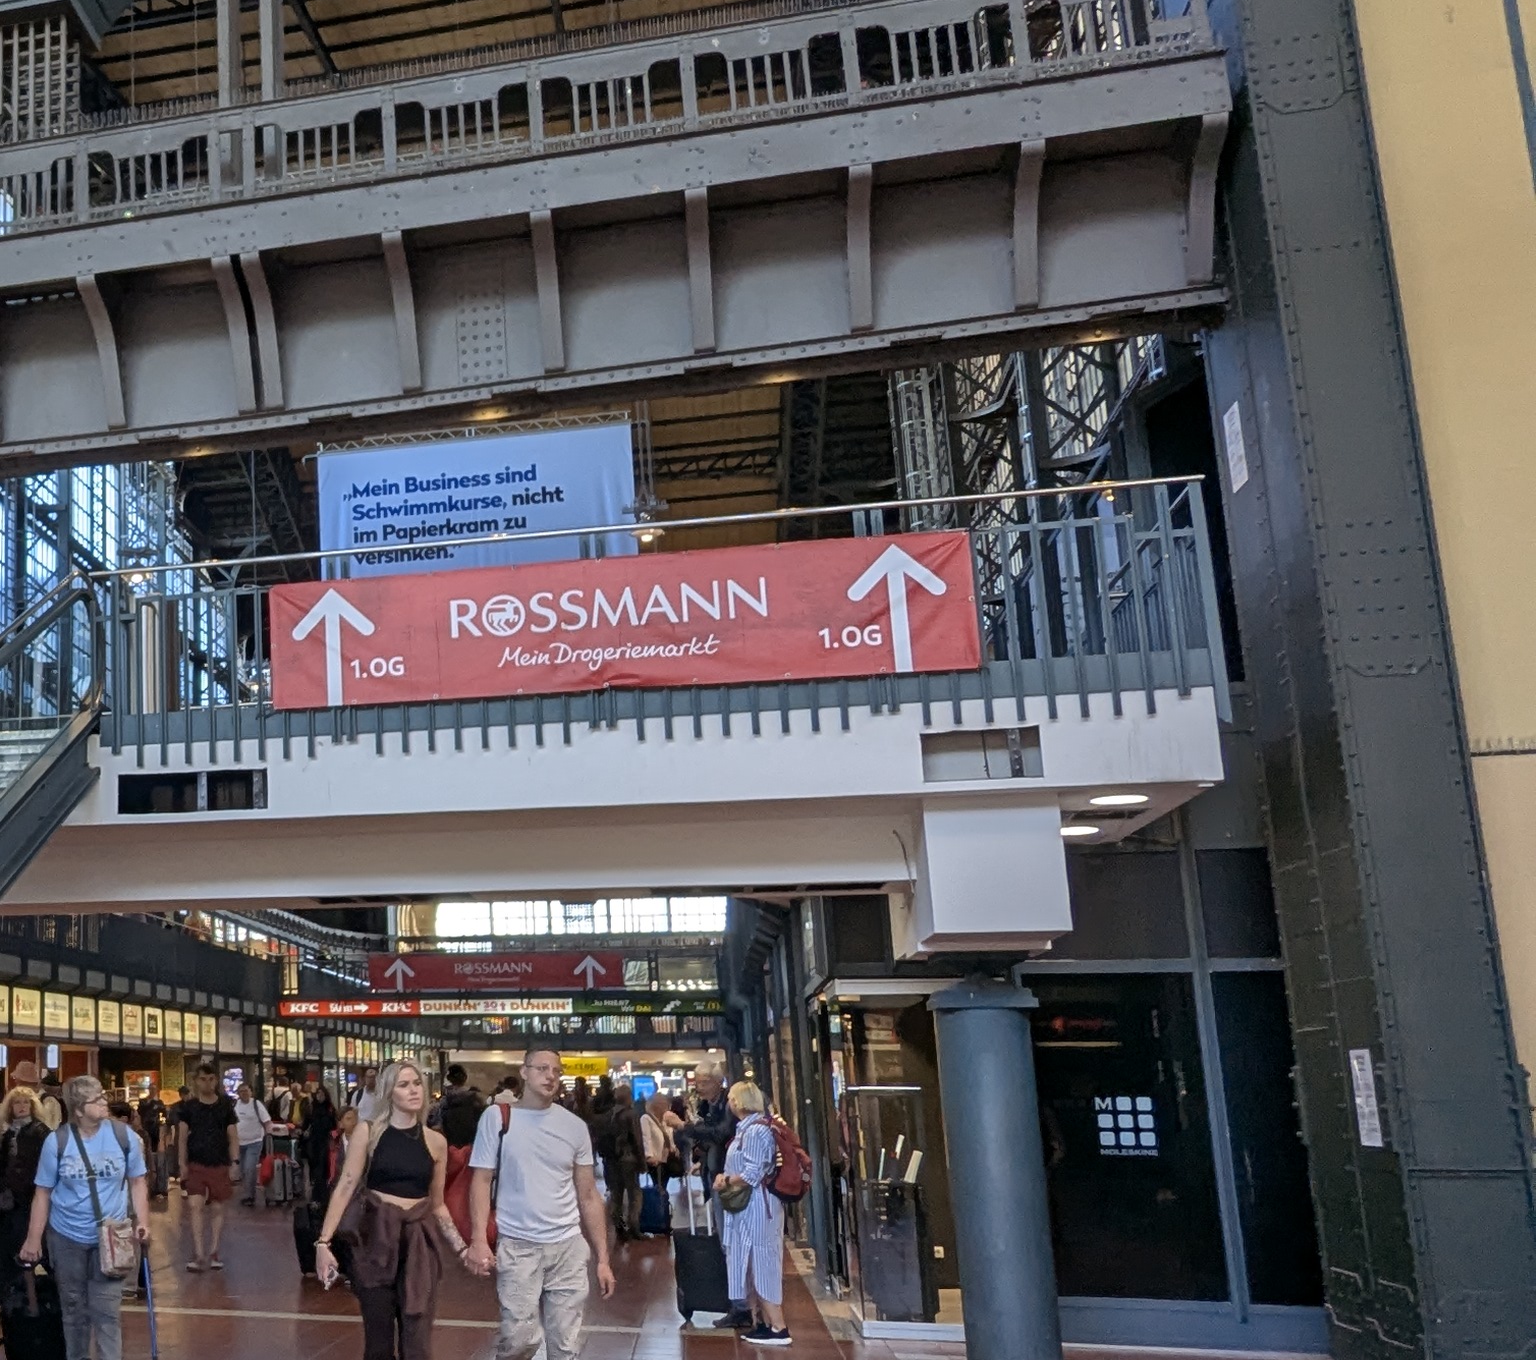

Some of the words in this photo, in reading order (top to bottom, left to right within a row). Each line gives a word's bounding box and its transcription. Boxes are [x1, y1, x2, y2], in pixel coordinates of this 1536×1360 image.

[404, 473, 491, 494] Business
[495, 463, 537, 484] sind
[352, 495, 508, 522] Schwimmkurse,
[511, 485, 564, 506] nicht
[353, 526, 377, 544] im
[382, 518, 499, 545] Papierkram
[503, 516, 527, 530] zu
[449, 577, 768, 639] ROSSMANN
[818, 624, 883, 650] 1.OG
[498, 645, 552, 669] Mein
[550, 633, 720, 670] Drogeriemarkt
[454, 962, 533, 975] ROSSMANN
[289, 1002, 319, 1013] KFC
[381, 1002, 412, 1013] KFC
[1094, 1096, 1113, 1111] M
[1100, 1148, 1158, 1156] MOLESKINE
